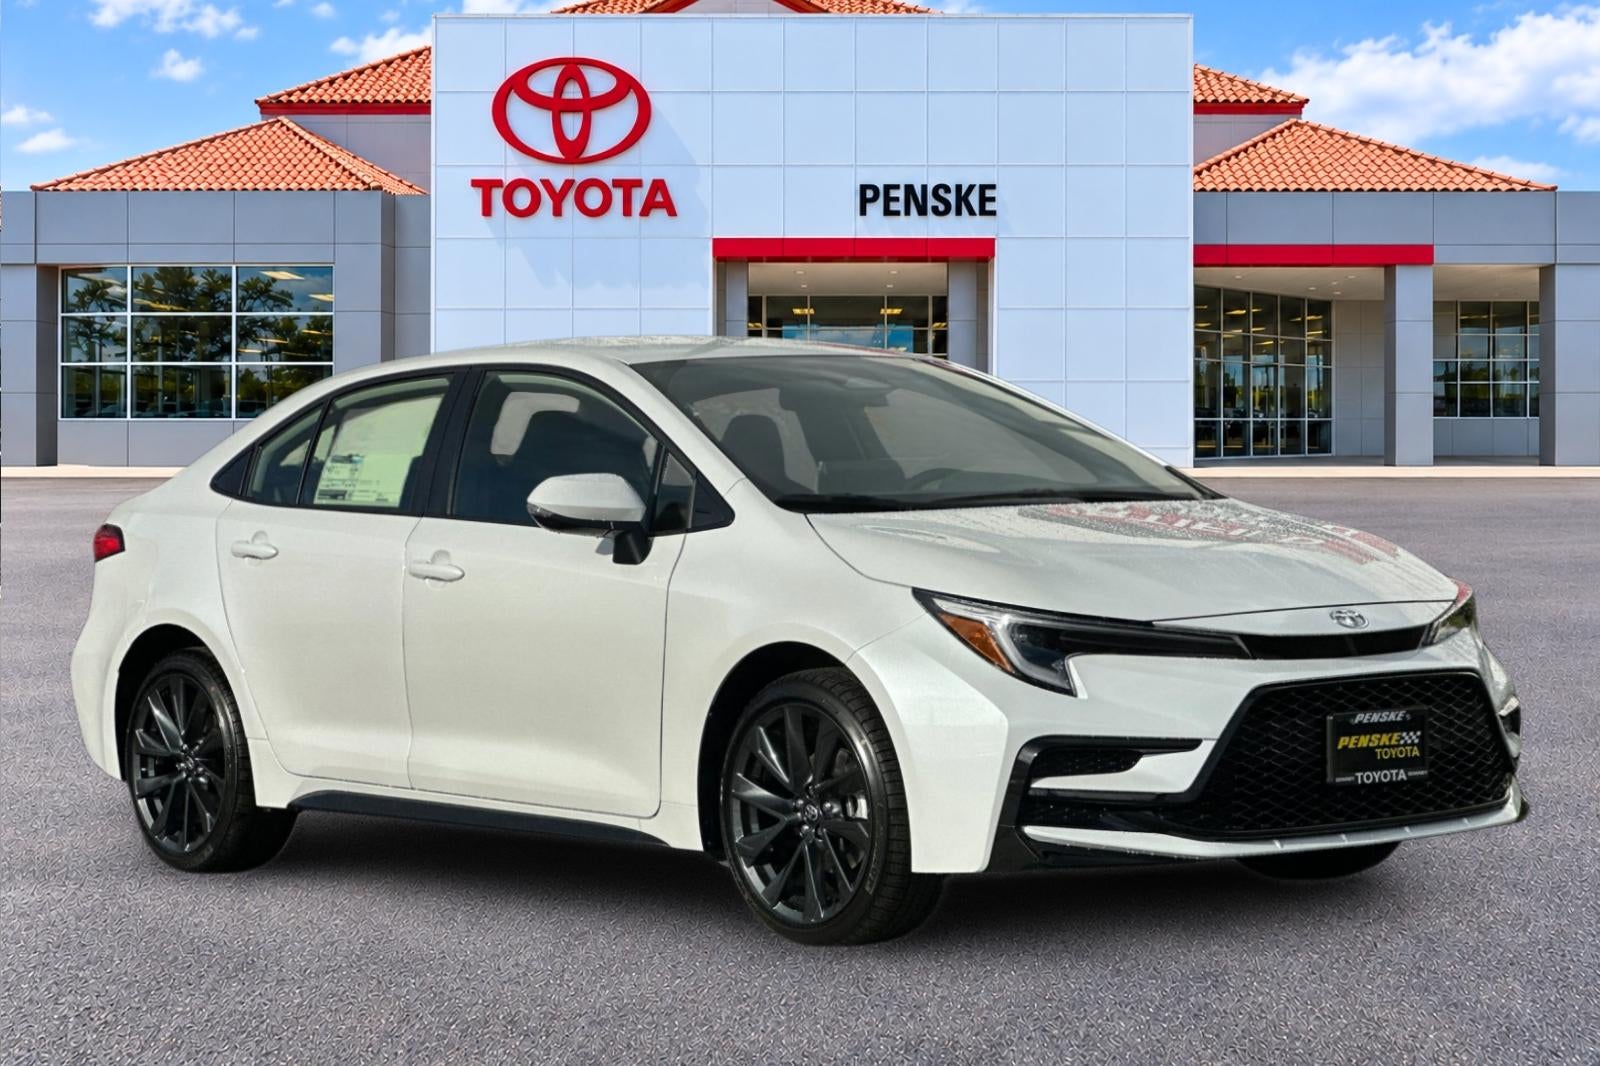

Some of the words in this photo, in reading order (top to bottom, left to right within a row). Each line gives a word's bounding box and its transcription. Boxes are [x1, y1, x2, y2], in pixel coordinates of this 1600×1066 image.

[471, 179, 677, 217] TOYOTA
[858, 184, 997, 216] PENSKE
[1354, 711, 1406, 723] PENSKE
[1337, 733, 1401, 749] PENSKE
[1375, 746, 1420, 759] TOYOTA
[1355, 769, 1407, 784] TOYOTA
